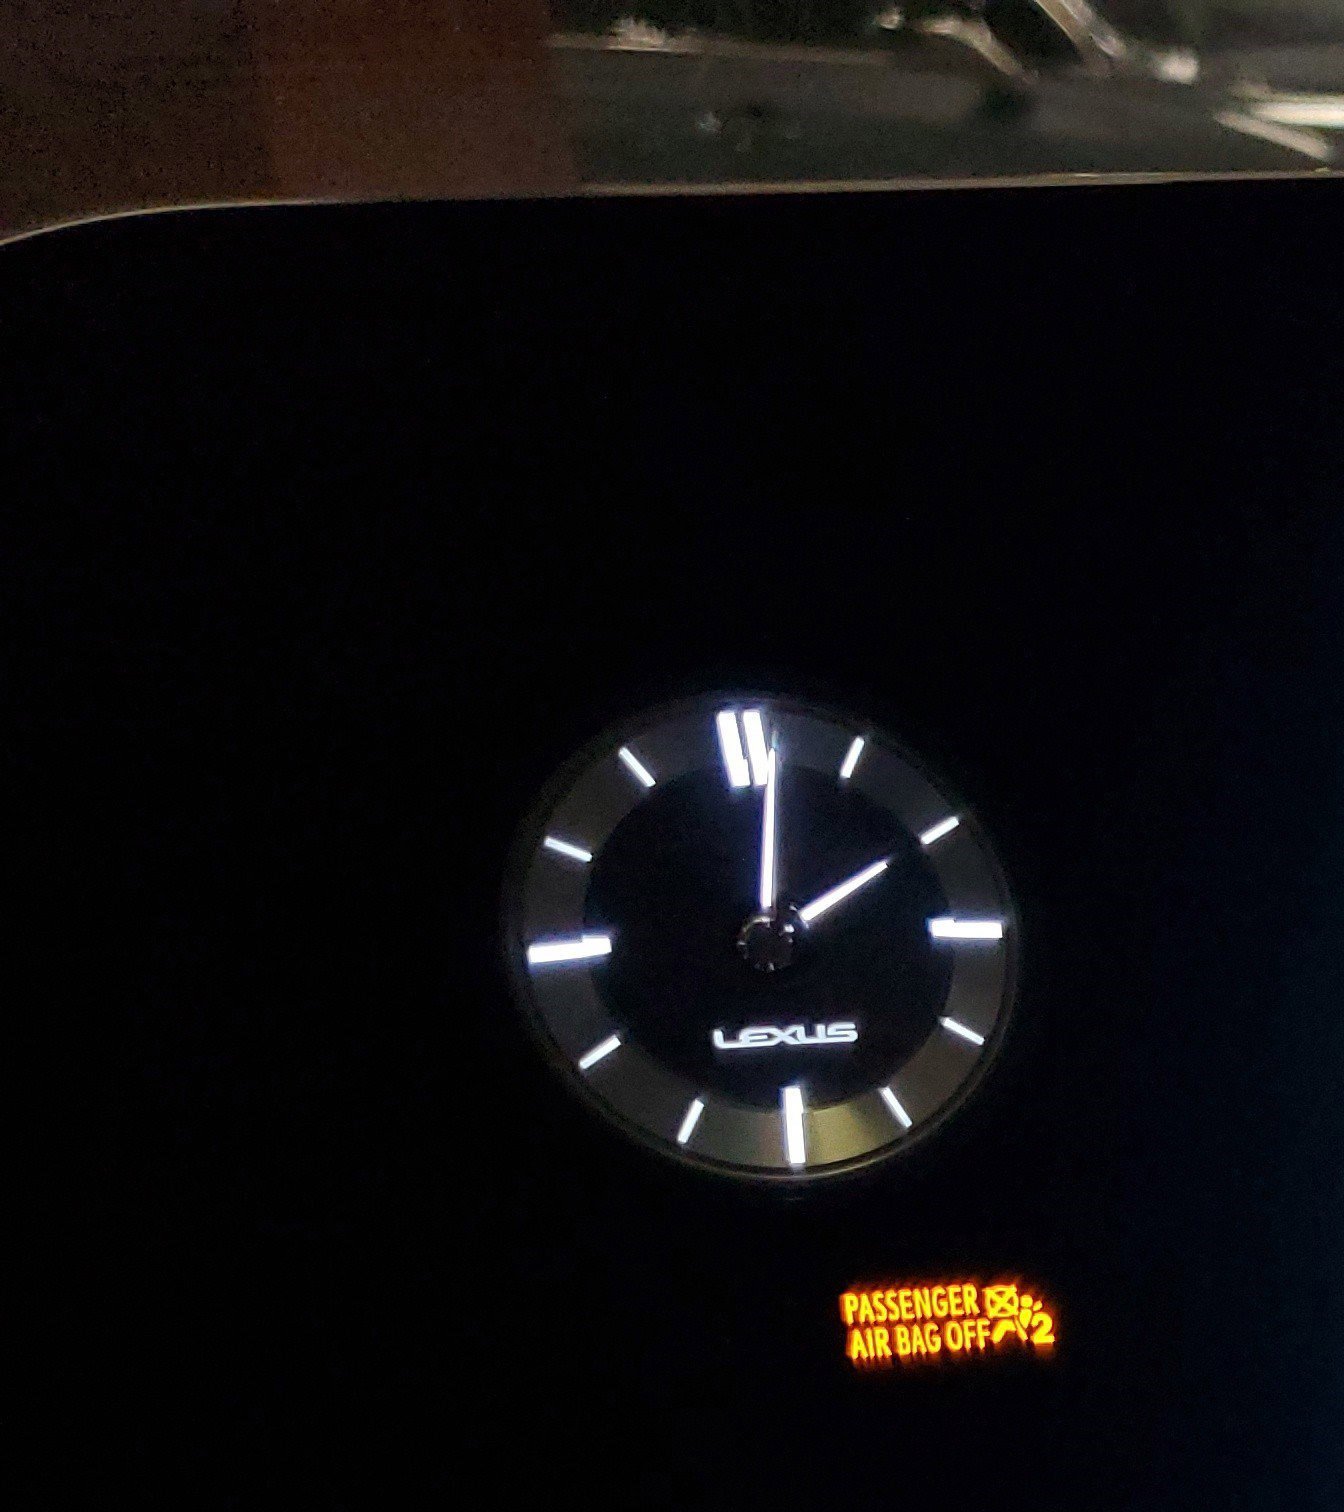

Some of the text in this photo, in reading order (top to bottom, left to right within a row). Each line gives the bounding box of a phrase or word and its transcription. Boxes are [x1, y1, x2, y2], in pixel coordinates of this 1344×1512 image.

[713, 1021, 858, 1050] LEXUS
[843, 1284, 980, 1324] PASSENGER
[849, 1317, 990, 1359] AIR BAG OFF
